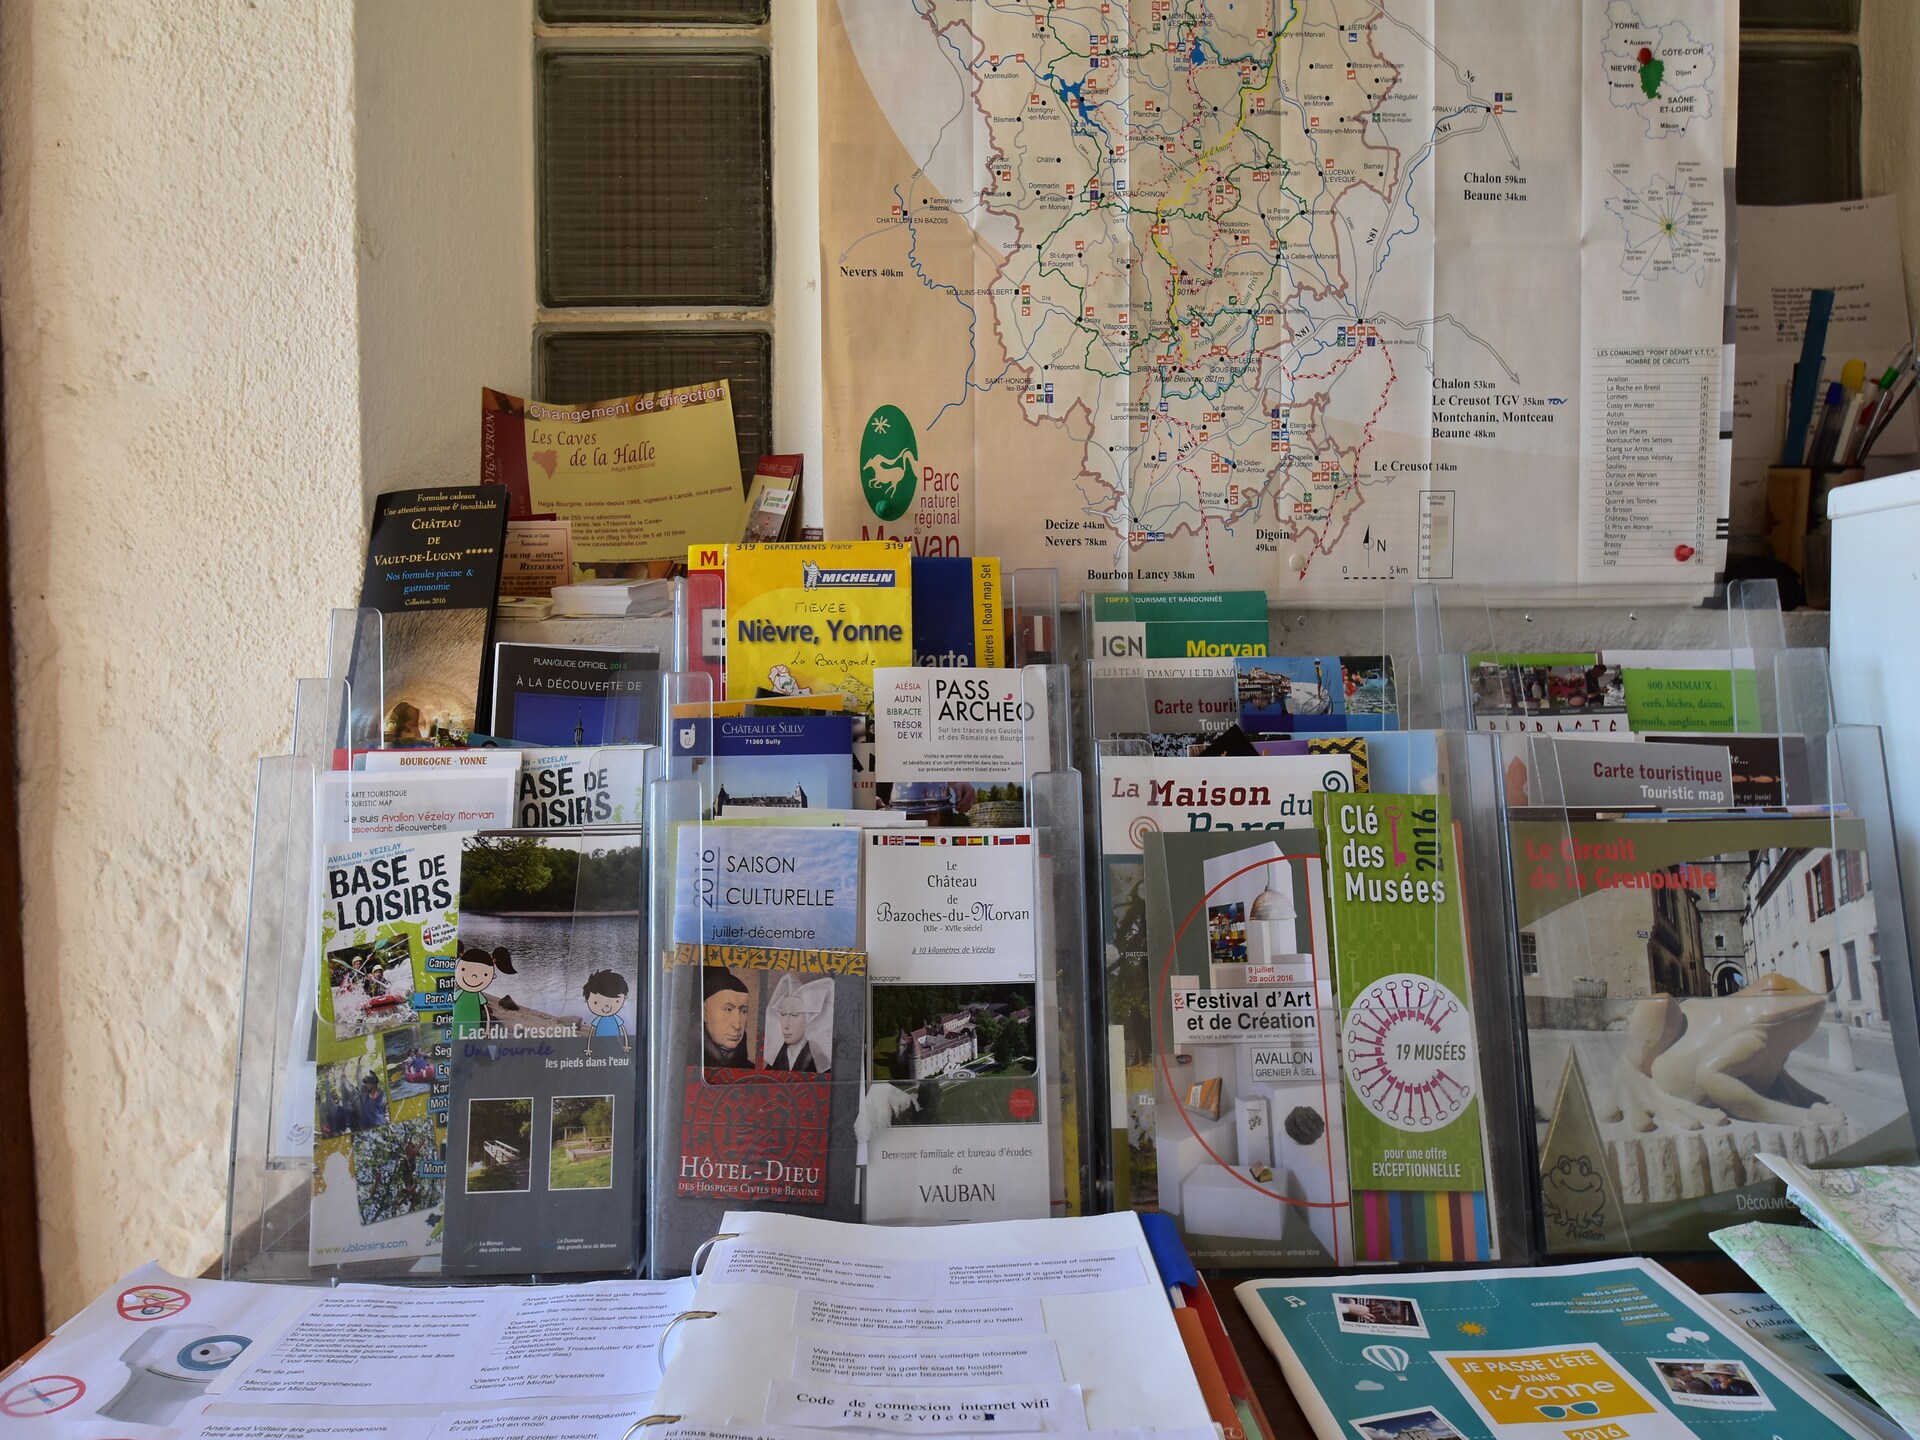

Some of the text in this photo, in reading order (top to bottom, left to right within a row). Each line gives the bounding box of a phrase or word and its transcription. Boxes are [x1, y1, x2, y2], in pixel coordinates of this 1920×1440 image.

[1662, 48, 1704, 56] CÔTE-D'OR
[1667, 96, 1697, 104] SAÔNE-
[1464, 172, 1527, 184] Chalon 59km
[1464, 190, 1527, 201] Beaune 34km
[840, 267, 904, 278] Nevers 40km
[1432, 378, 1496, 389] Chalon 53km
[530, 384, 726, 424] Changement de direction
[1432, 395, 1545, 406] Le Creusot TGV 35km
[1432, 412, 1554, 424] Montchanin, Montceau
[531, 429, 597, 445] Les Caves
[1432, 427, 1496, 438] Beaune 48km
[570, 441, 655, 467] de la Halle
[1373, 461, 1457, 472] Le Creusot 14km
[922, 468, 960, 491] Parc
[920, 492, 960, 508] naturel
[914, 508, 960, 524] régional
[411, 516, 461, 531] CHÂTEAU
[1045, 519, 1105, 531] Decize 44km
[427, 535, 440, 545] DE
[1045, 536, 1107, 547] Nevers 78km
[1256, 529, 1289, 542] Digoin
[1256, 544, 1277, 553] 49km
[374, 549, 463, 566] VAULT-DE-LUGNY
[385, 569, 462, 582] Nos formules piscine
[822, 572, 893, 583] MICHELIN
[1087, 570, 1196, 582] Bourbon Lancy 38km
[404, 582, 450, 594] gastronomie
[738, 618, 903, 645] Nièvre, Yonne
[1102, 635, 1143, 657] IGN
[1186, 639, 1267, 657] Morvan
[895, 682, 921, 691] ALÉSIA
[936, 680, 990, 700] PASS
[1647, 680, 1712, 691] 400 ANIMAUX
[894, 695, 921, 703] AUTUN
[886, 707, 922, 716] BIBRACTE
[938, 693, 1035, 722] ARCHÉO
[722, 722, 804, 735] CHÂTEAU DE SULLY
[893, 720, 922, 729] TRÉSOR
[765, 738, 781, 746] Sully
[898, 731, 923, 739] DE VIX
[400, 756, 487, 767] BOURGOGNE YONNE
[1593, 762, 1723, 784] Carte touristique
[1112, 776, 1271, 806] La Maison
[1640, 786, 1694, 800] Touristic
[1699, 789, 1724, 803] map
[359, 810, 494, 823] suis Avallon Vézelay Morvan
[1341, 803, 1379, 835] Clé
[1412, 808, 1444, 872] 2016
[1343, 840, 1385, 868] des
[1526, 837, 1636, 862] Le Circuit
[726, 855, 795, 874] SAISON
[946, 861, 957, 871] Le
[330, 855, 446, 899] BASE DE
[927, 873, 977, 888] Château
[1531, 866, 1717, 889] de la Grenouille
[1345, 871, 1445, 904] Musées
[726, 888, 834, 907] CULTURELLE
[947, 895, 958, 905] de
[337, 879, 452, 931] LOISIRS
[711, 925, 815, 940] juillet-décembre
[1248, 965, 1274, 975] 9 juillet
[1185, 991, 1311, 1009] Festival d'Art
[1187, 1012, 1315, 1030] et de Création
[459, 1022, 578, 1040] Lac du Crescent
[1396, 1041, 1466, 1061] 19 MUSÉES
[545, 1056, 629, 1069] les pieds dans l'eau
[1255, 1052, 1313, 1065] AVALLON
[1256, 1066, 1316, 1077] GRENIER À SEL
[1384, 1147, 1447, 1161] pour une offre
[952, 1164, 962, 1175] de
[1372, 1162, 1461, 1178] EXCEPTIONNELLE
[919, 1184, 995, 1203] VAUBAN
[1463, 1353, 1598, 1374] JE PASSE L'ÉTÉ
[1519, 1372, 1561, 1384] DANS
[796, 1392, 1050, 1412] Code de connexion internet wifi
[1571, 1426, 1621, 1440] 2016
